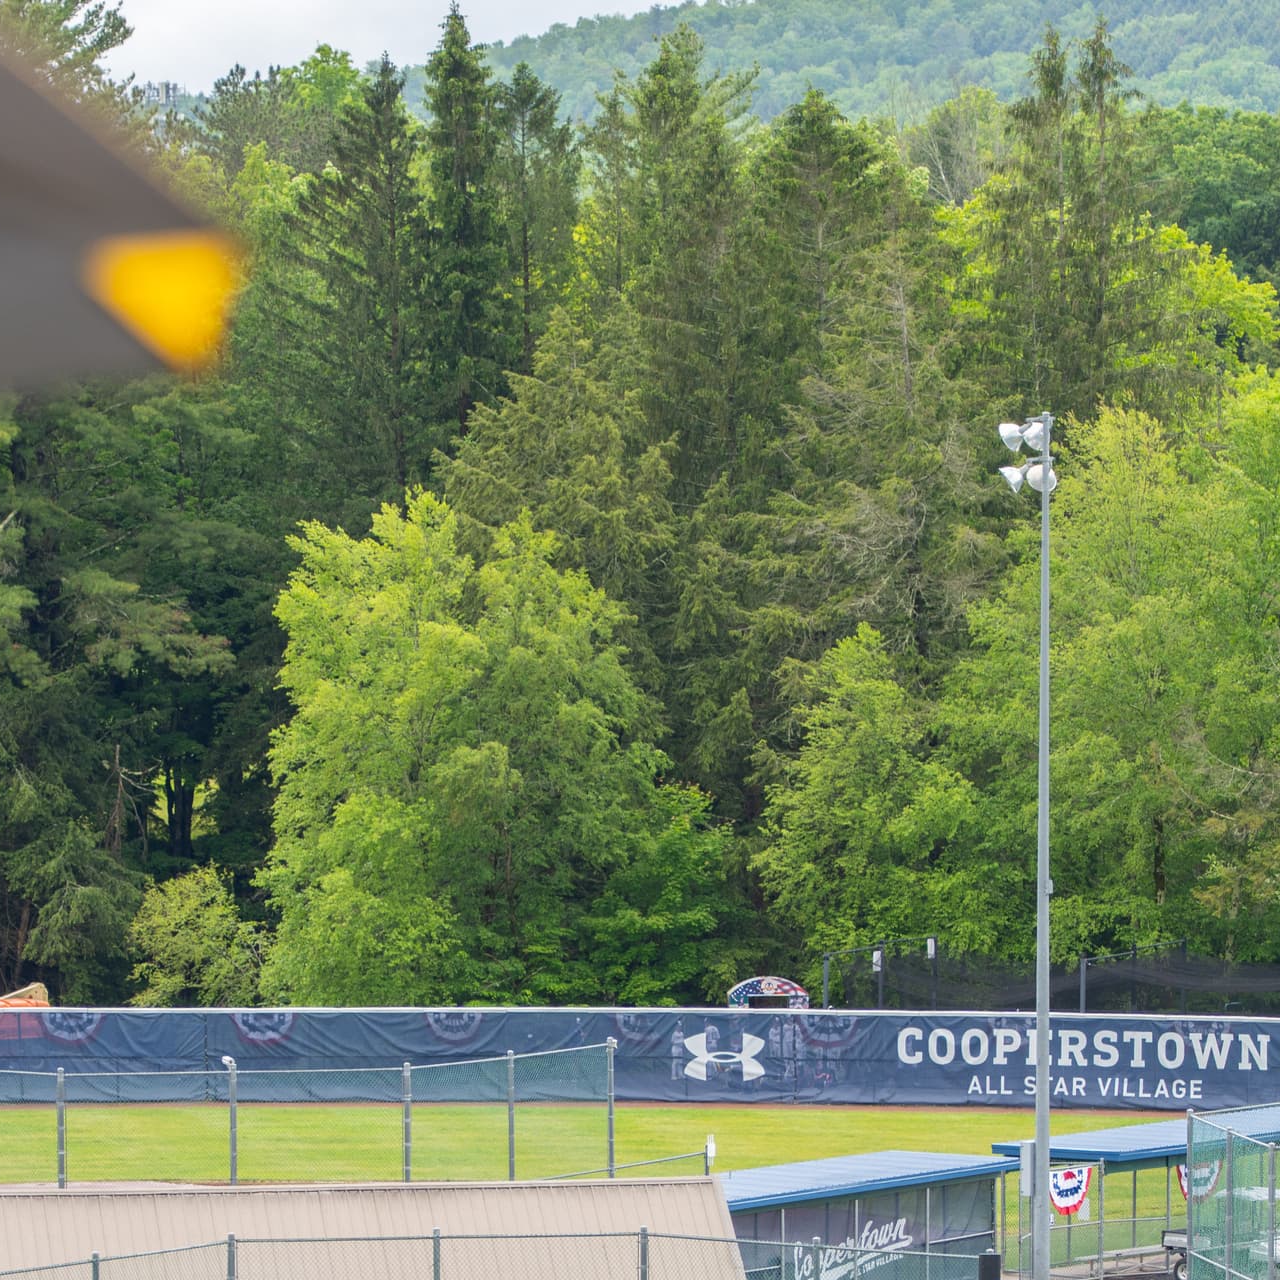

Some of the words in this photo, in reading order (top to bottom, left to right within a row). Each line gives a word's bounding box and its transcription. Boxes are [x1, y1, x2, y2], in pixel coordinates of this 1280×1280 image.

[967, 1075, 1013, 1095] ALL
[1023, 1076, 1086, 1096] SAR
[1097, 1077, 1203, 1099] VILLAGE
